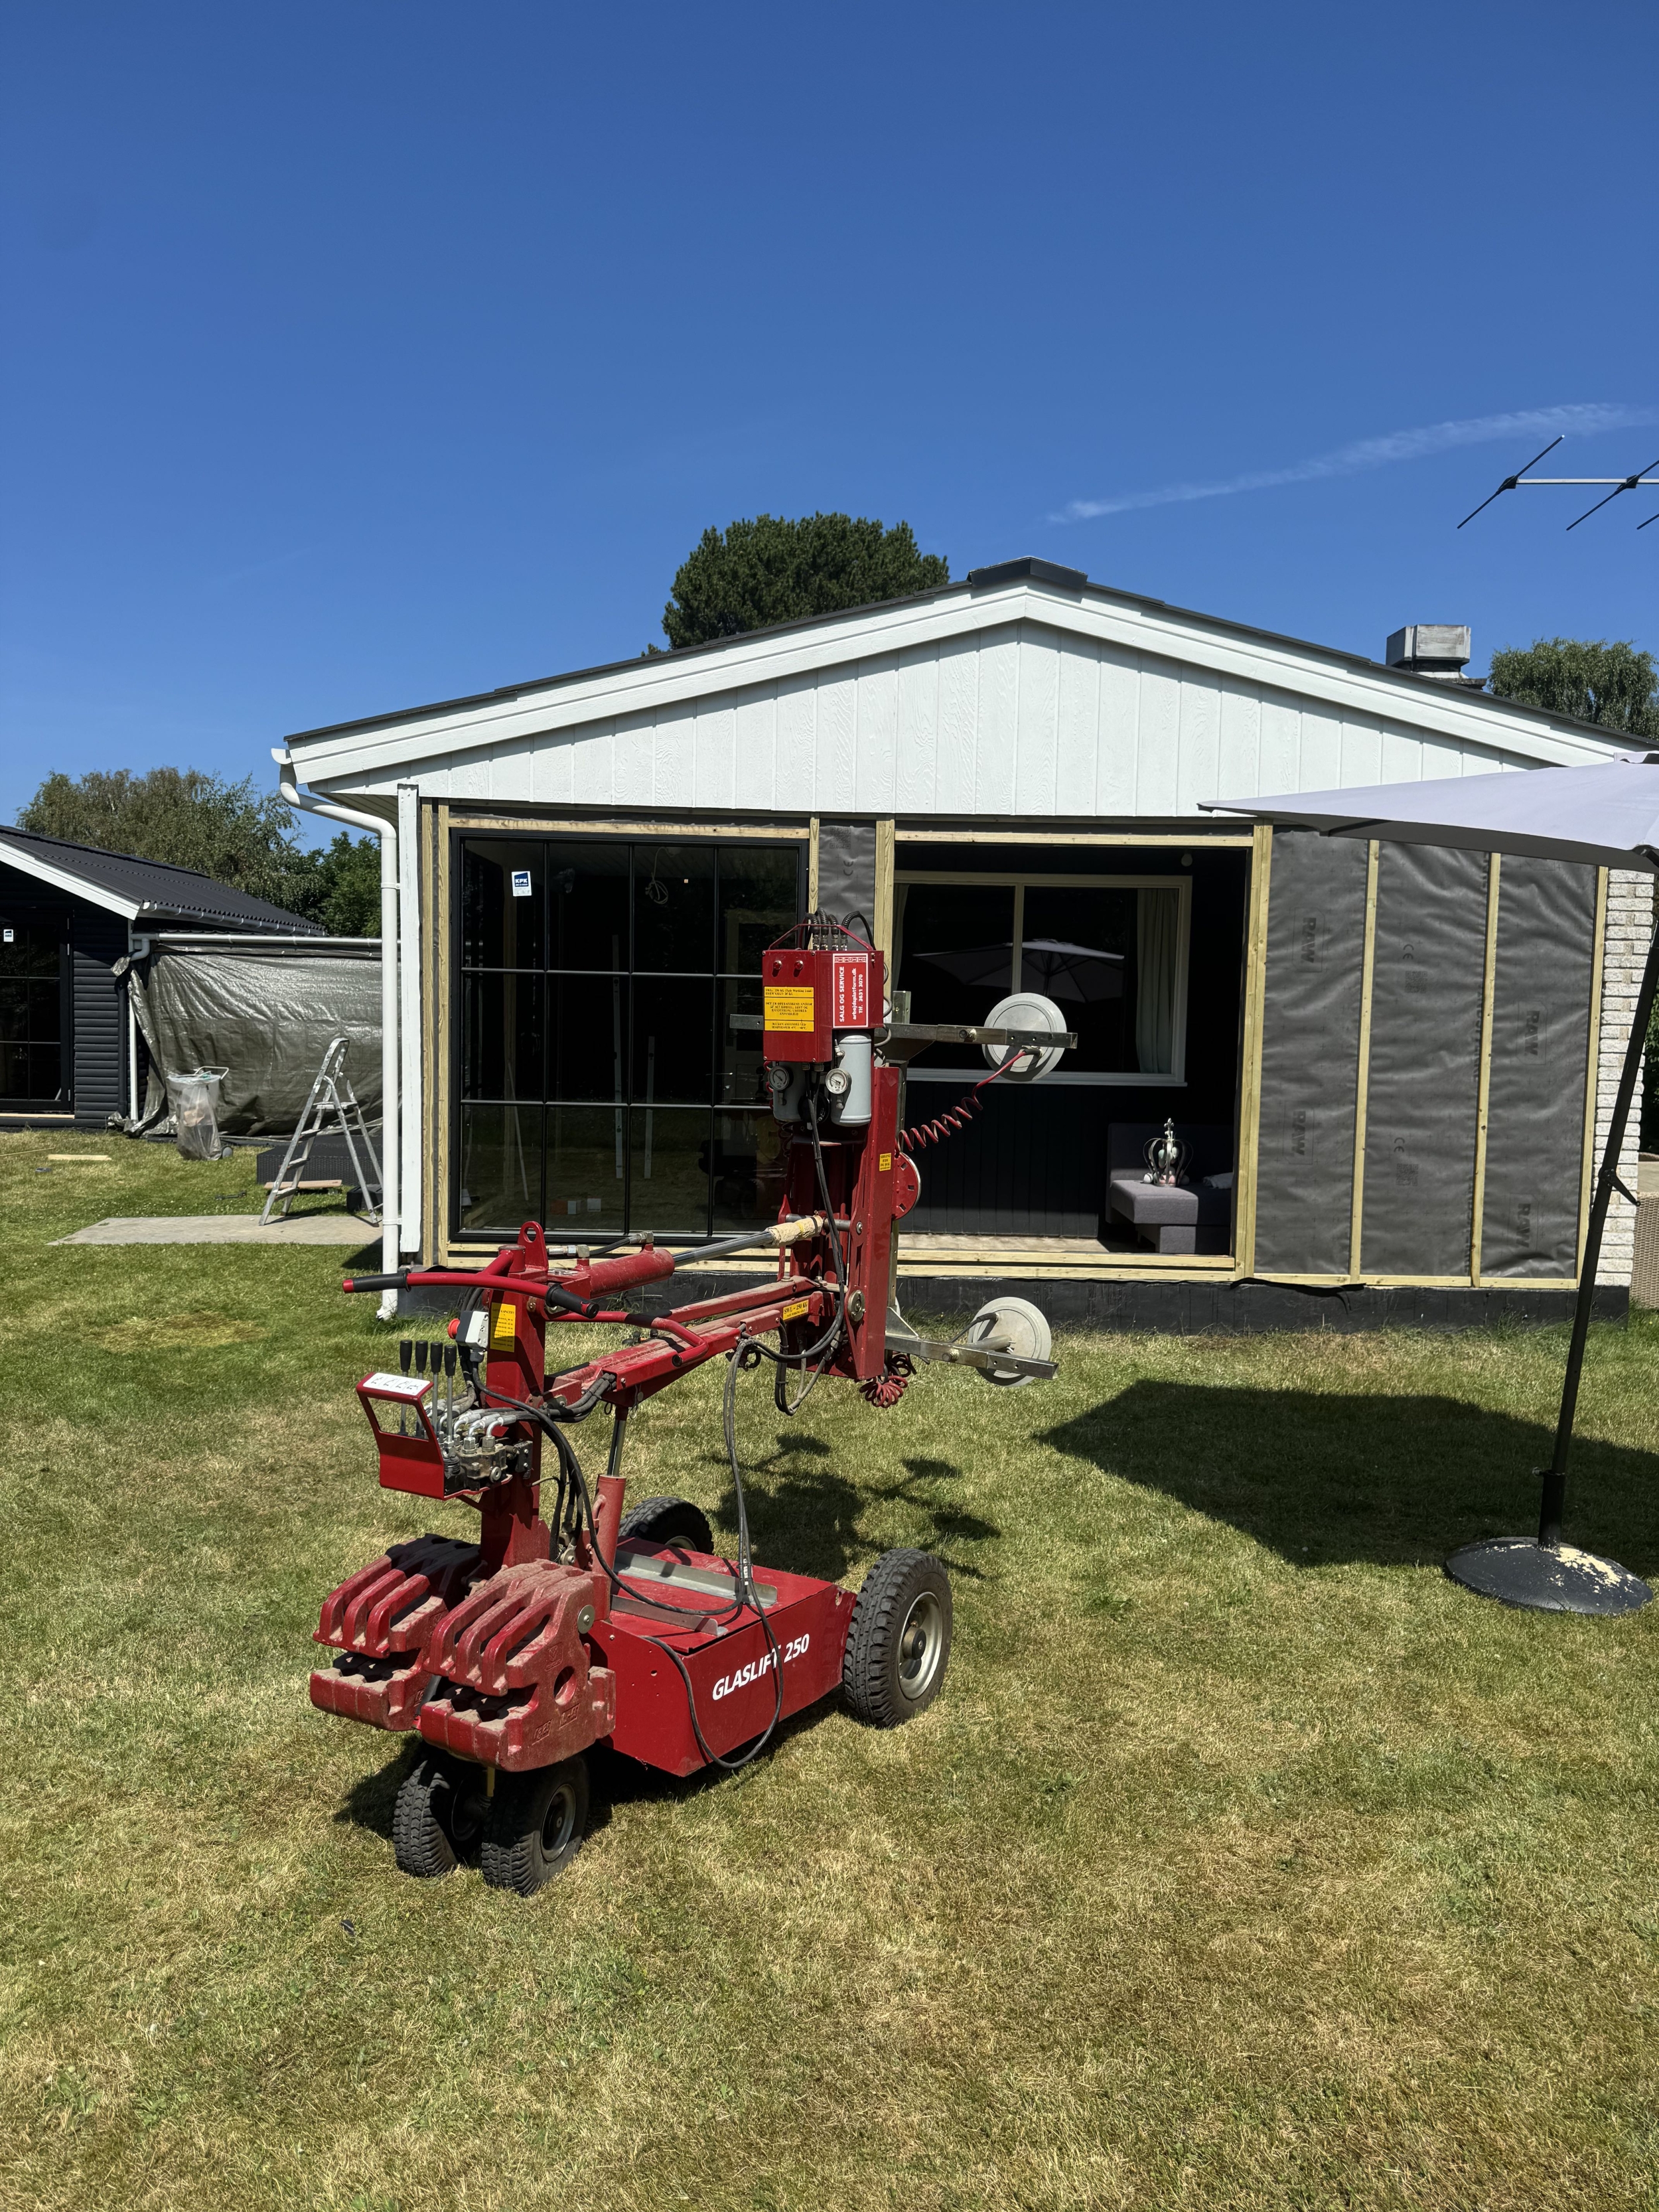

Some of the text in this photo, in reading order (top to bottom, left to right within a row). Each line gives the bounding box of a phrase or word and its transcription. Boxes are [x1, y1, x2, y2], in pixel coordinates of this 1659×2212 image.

[1301, 917, 1317, 964] RAW
[839, 994, 845, 1004] OG
[1525, 1010, 1540, 1056] RAW
[1291, 1110, 1306, 1155] RAW
[1516, 1203, 1531, 1248] RAW
[712, 1633, 810, 1701] GLASLIFT 250
